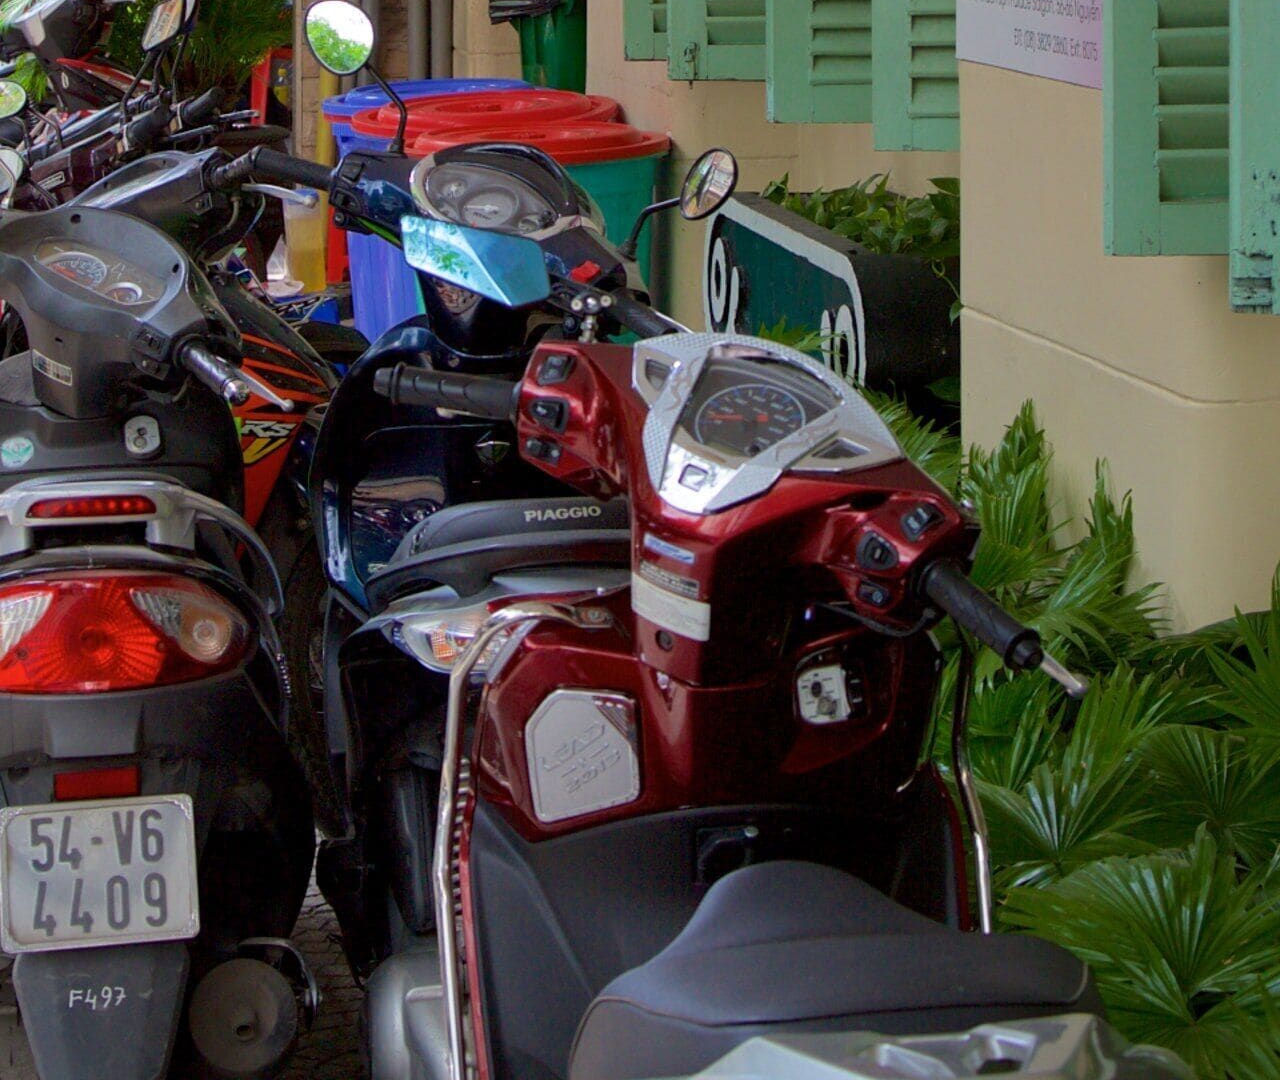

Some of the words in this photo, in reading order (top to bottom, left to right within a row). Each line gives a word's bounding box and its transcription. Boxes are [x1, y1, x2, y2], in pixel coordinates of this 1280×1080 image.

[524, 505, 602, 522] PIAGGIO
[29, 808, 165, 873] 54-V6
[33, 872, 168, 937] 4409
[68, 985, 127, 1010] F497
